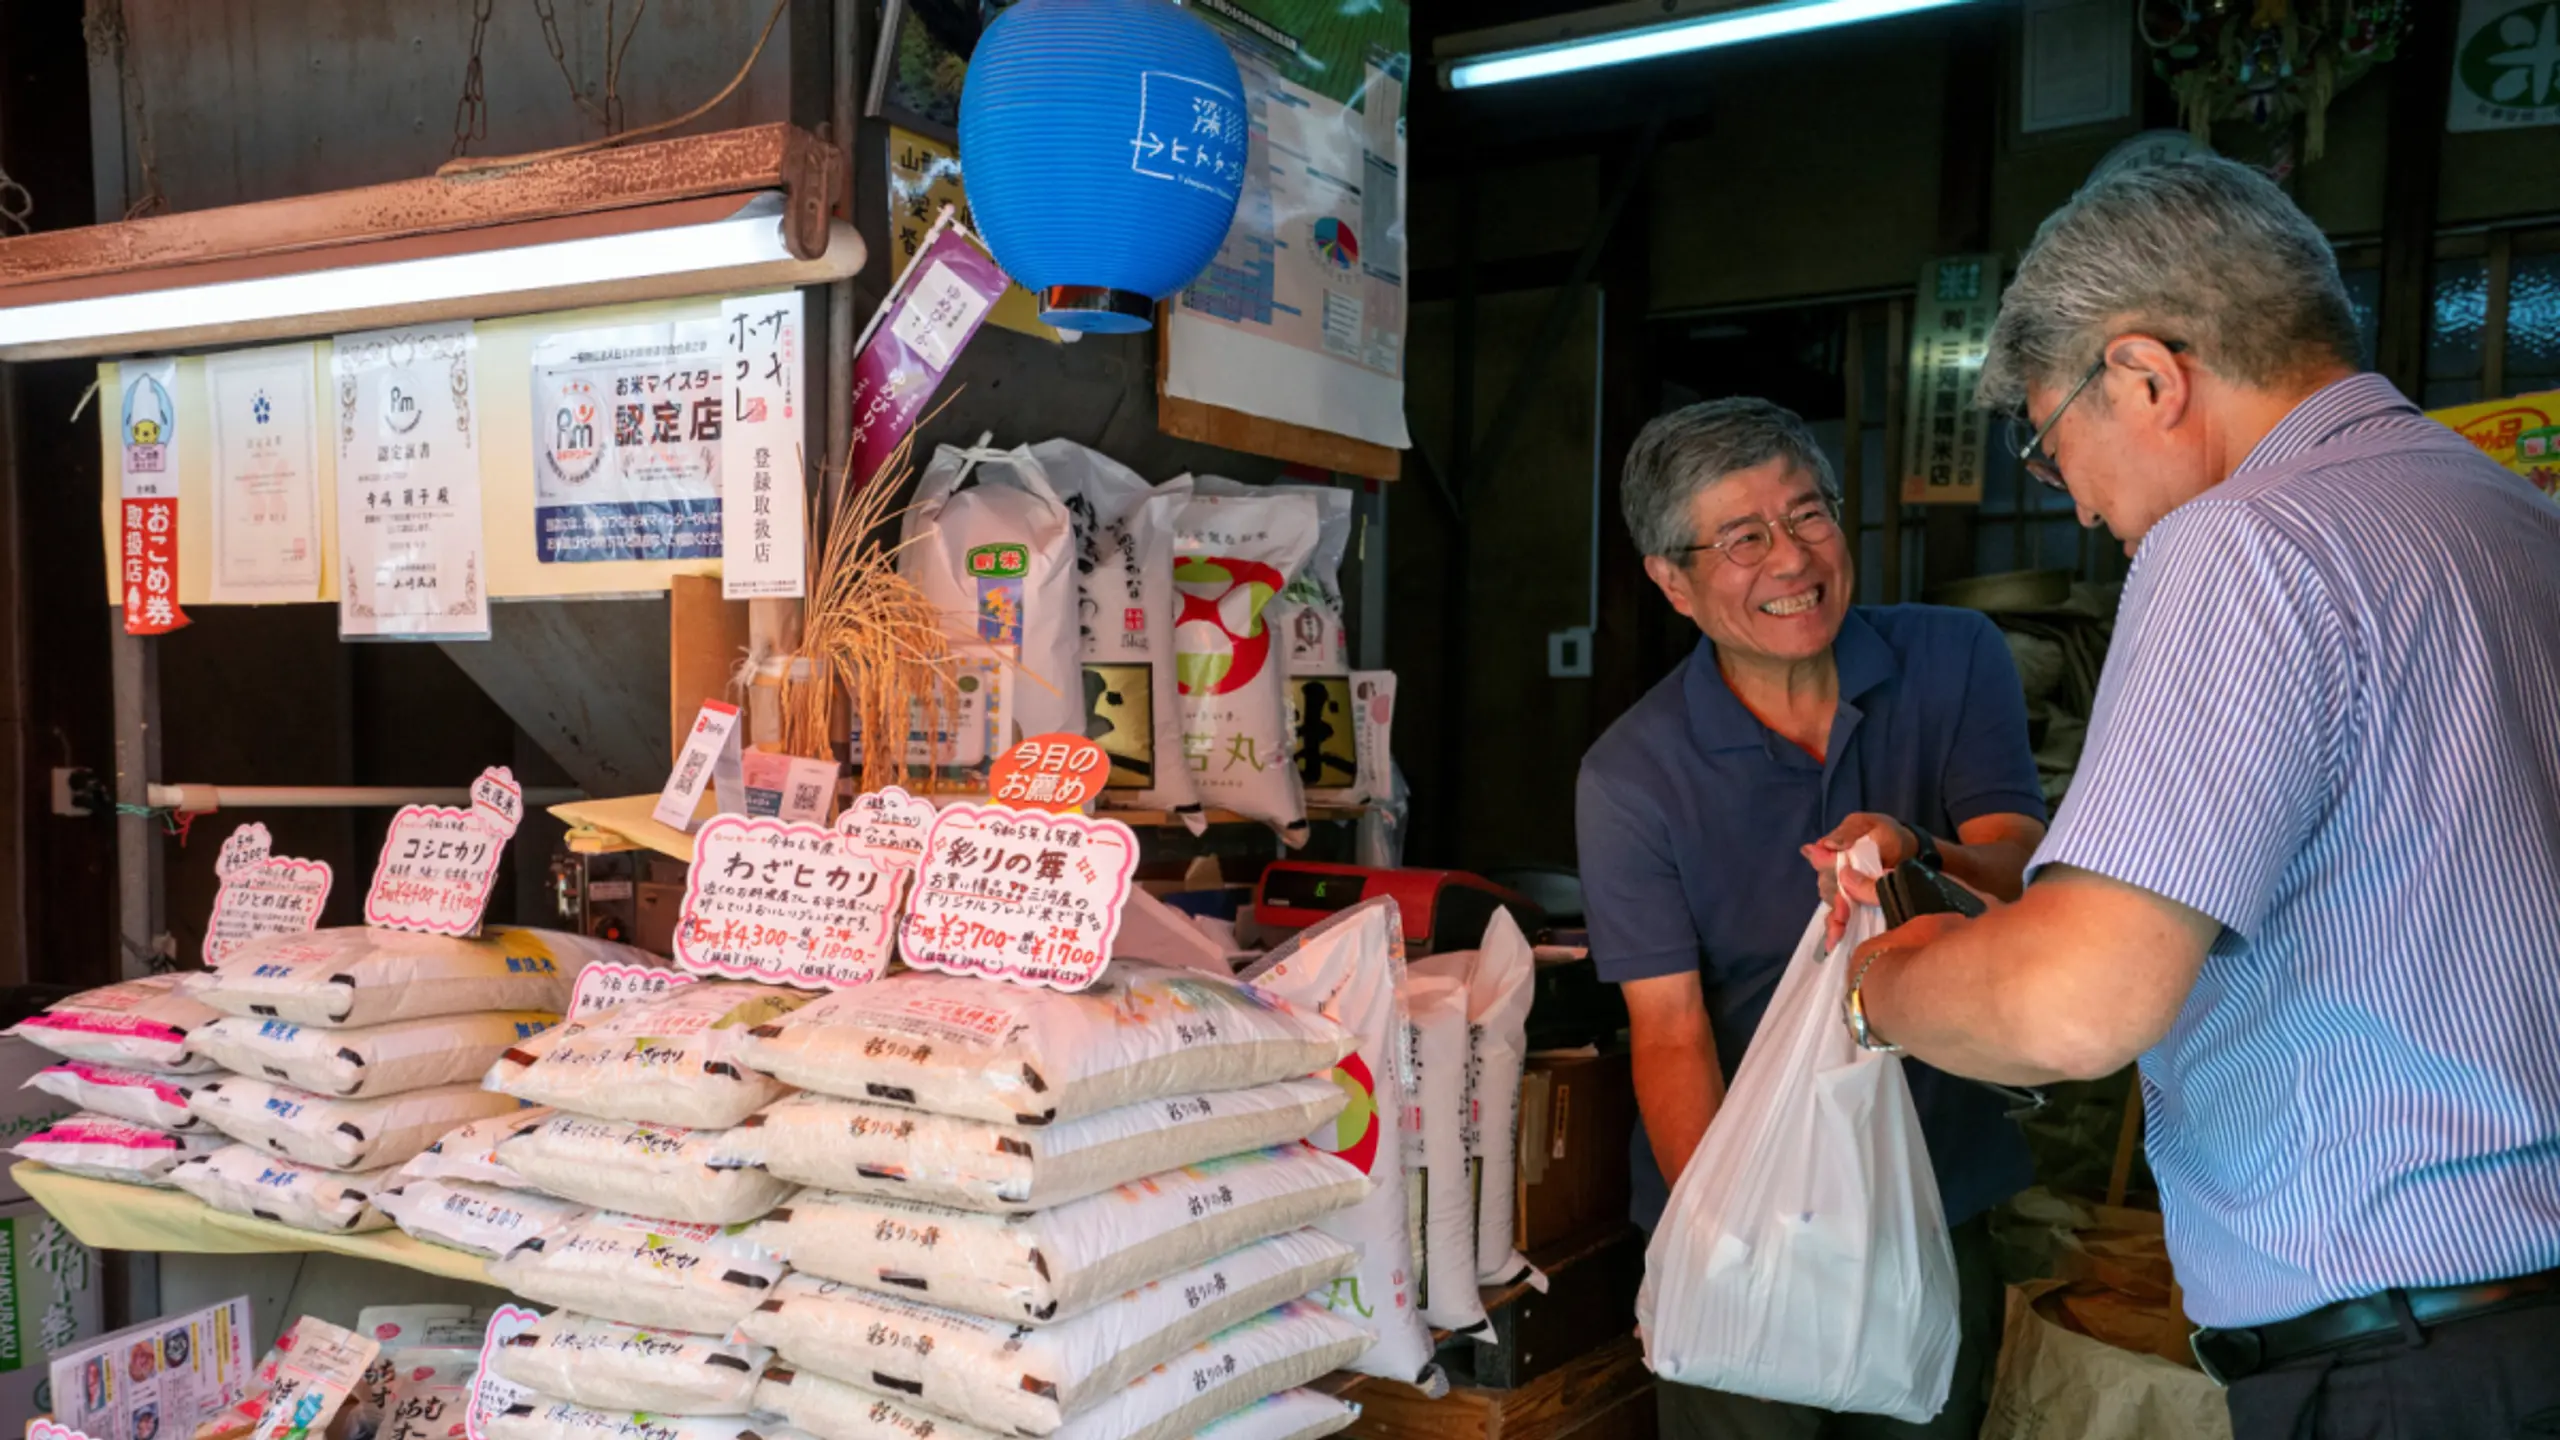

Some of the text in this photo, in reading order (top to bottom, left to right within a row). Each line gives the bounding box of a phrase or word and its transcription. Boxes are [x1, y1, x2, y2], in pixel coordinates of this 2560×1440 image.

[614, 397, 723, 447] 認定店
[753, 447, 772, 564] 登録取扱店
[125, 504, 142, 583] 取扱店
[147, 503, 174, 626] おこめ券
[1015, 741, 1099, 773] 今月の
[403, 838, 486, 865] コシヒカリ
[723, 851, 878, 898] わざヒカリ
[945, 836, 1068, 885] 彩りの舞
